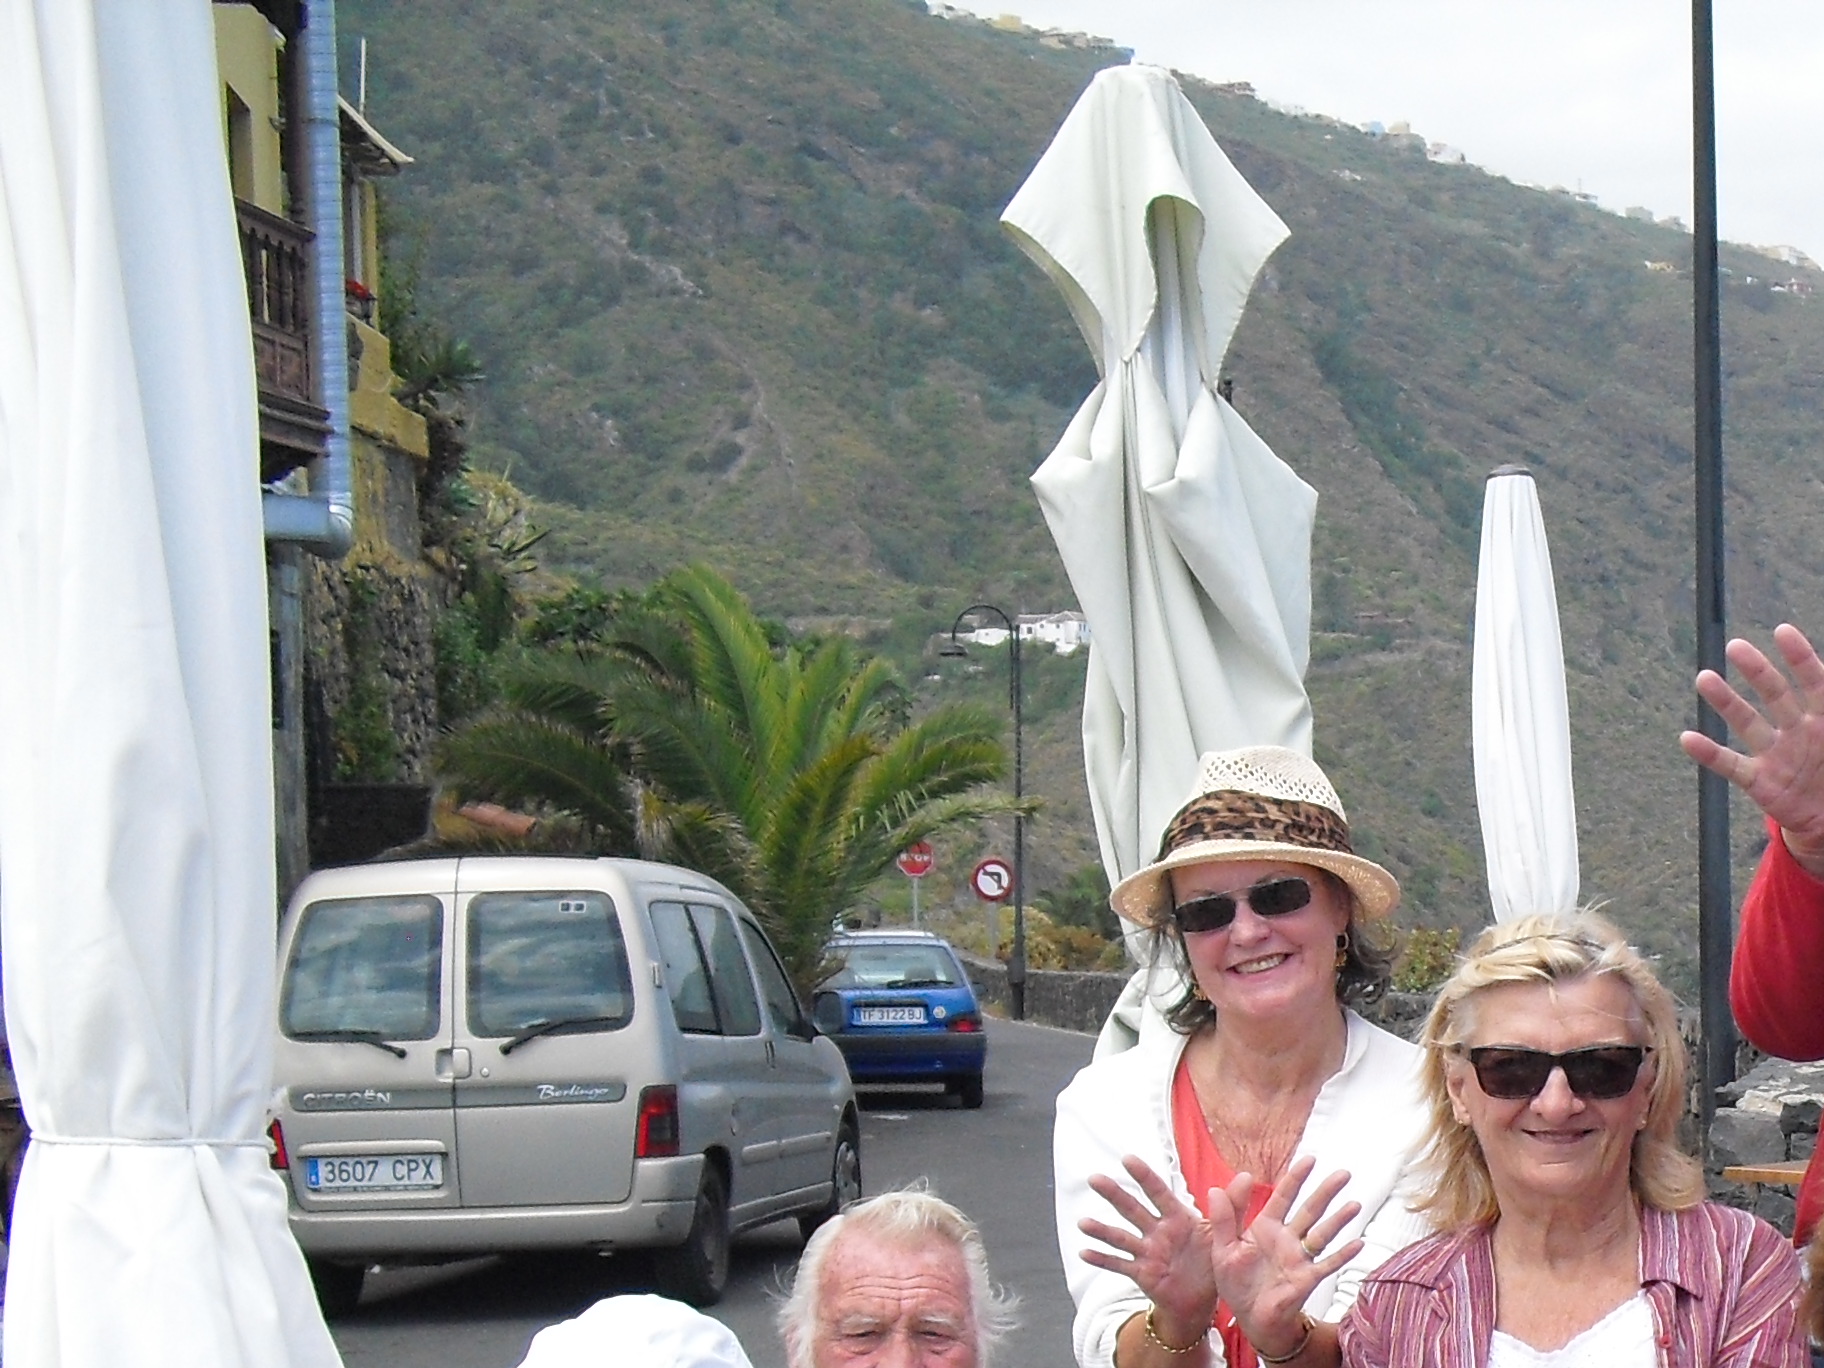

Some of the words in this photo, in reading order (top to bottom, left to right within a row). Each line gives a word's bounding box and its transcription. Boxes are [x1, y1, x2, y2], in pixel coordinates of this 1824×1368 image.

[862, 1009, 876, 1020] TF
[878, 1008, 905, 1020] 3122
[303, 1089, 391, 1107] CITROËN
[537, 1084, 609, 1100] Berlingo
[324, 1160, 374, 1183] 3607
[392, 1158, 435, 1182] CPX
